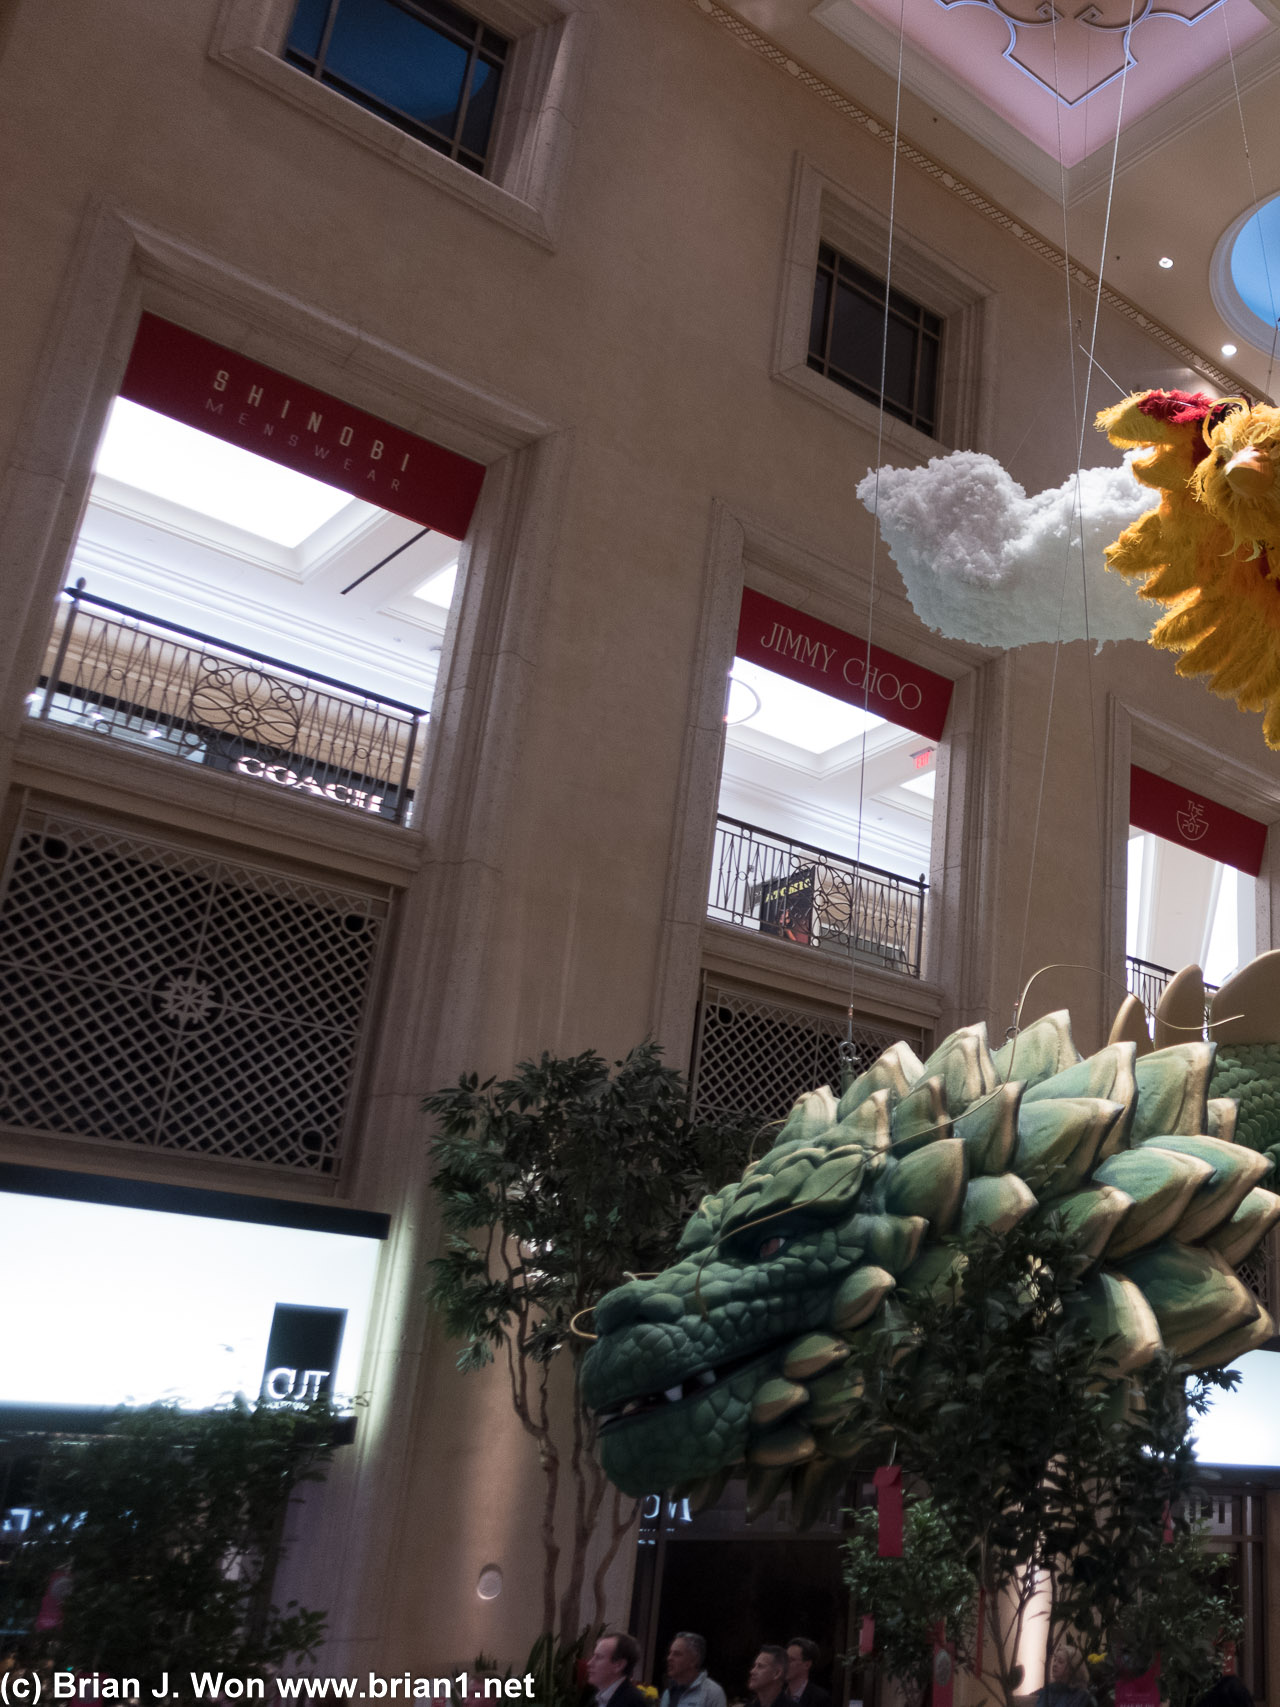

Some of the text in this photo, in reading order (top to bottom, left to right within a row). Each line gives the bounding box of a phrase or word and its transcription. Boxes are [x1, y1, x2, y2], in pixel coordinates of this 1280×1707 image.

[205, 398, 400, 491] MENSWEAR
[213, 370, 409, 472] SHINOBI
[760, 622, 922, 710] JIMMY CHOO
[237, 756, 384, 813] COACH
[1188, 800, 1205, 816] THE
[1181, 819, 1201, 835] POT
[267, 1366, 331, 1401] CUT
